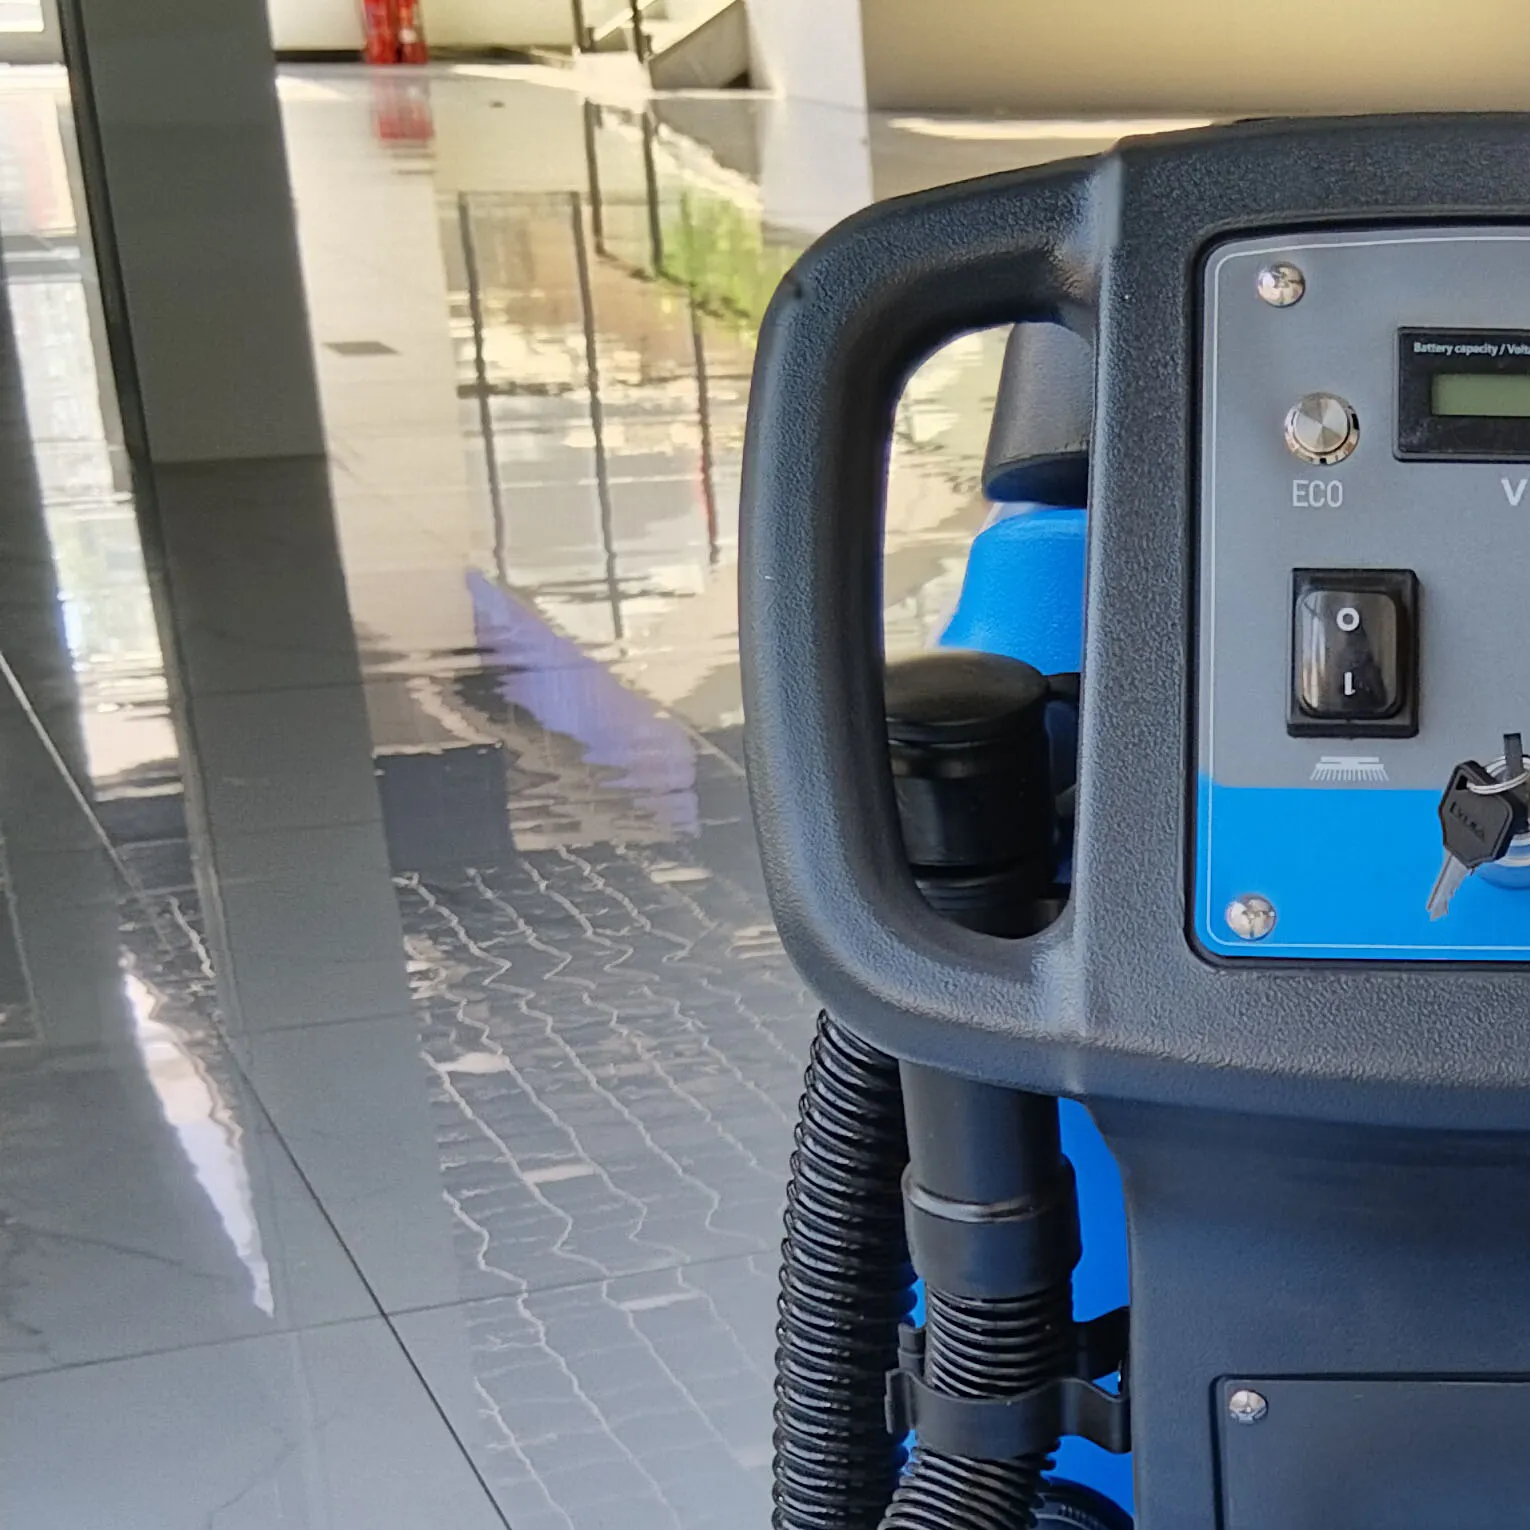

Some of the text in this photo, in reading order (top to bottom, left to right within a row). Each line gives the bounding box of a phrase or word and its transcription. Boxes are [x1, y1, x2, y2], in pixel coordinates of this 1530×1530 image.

[1413, 342, 1452, 355] Battery
[1454, 343, 1498, 356] capacity
[1292, 479, 1344, 507] ECO
[1501, 478, 1528, 506] V
